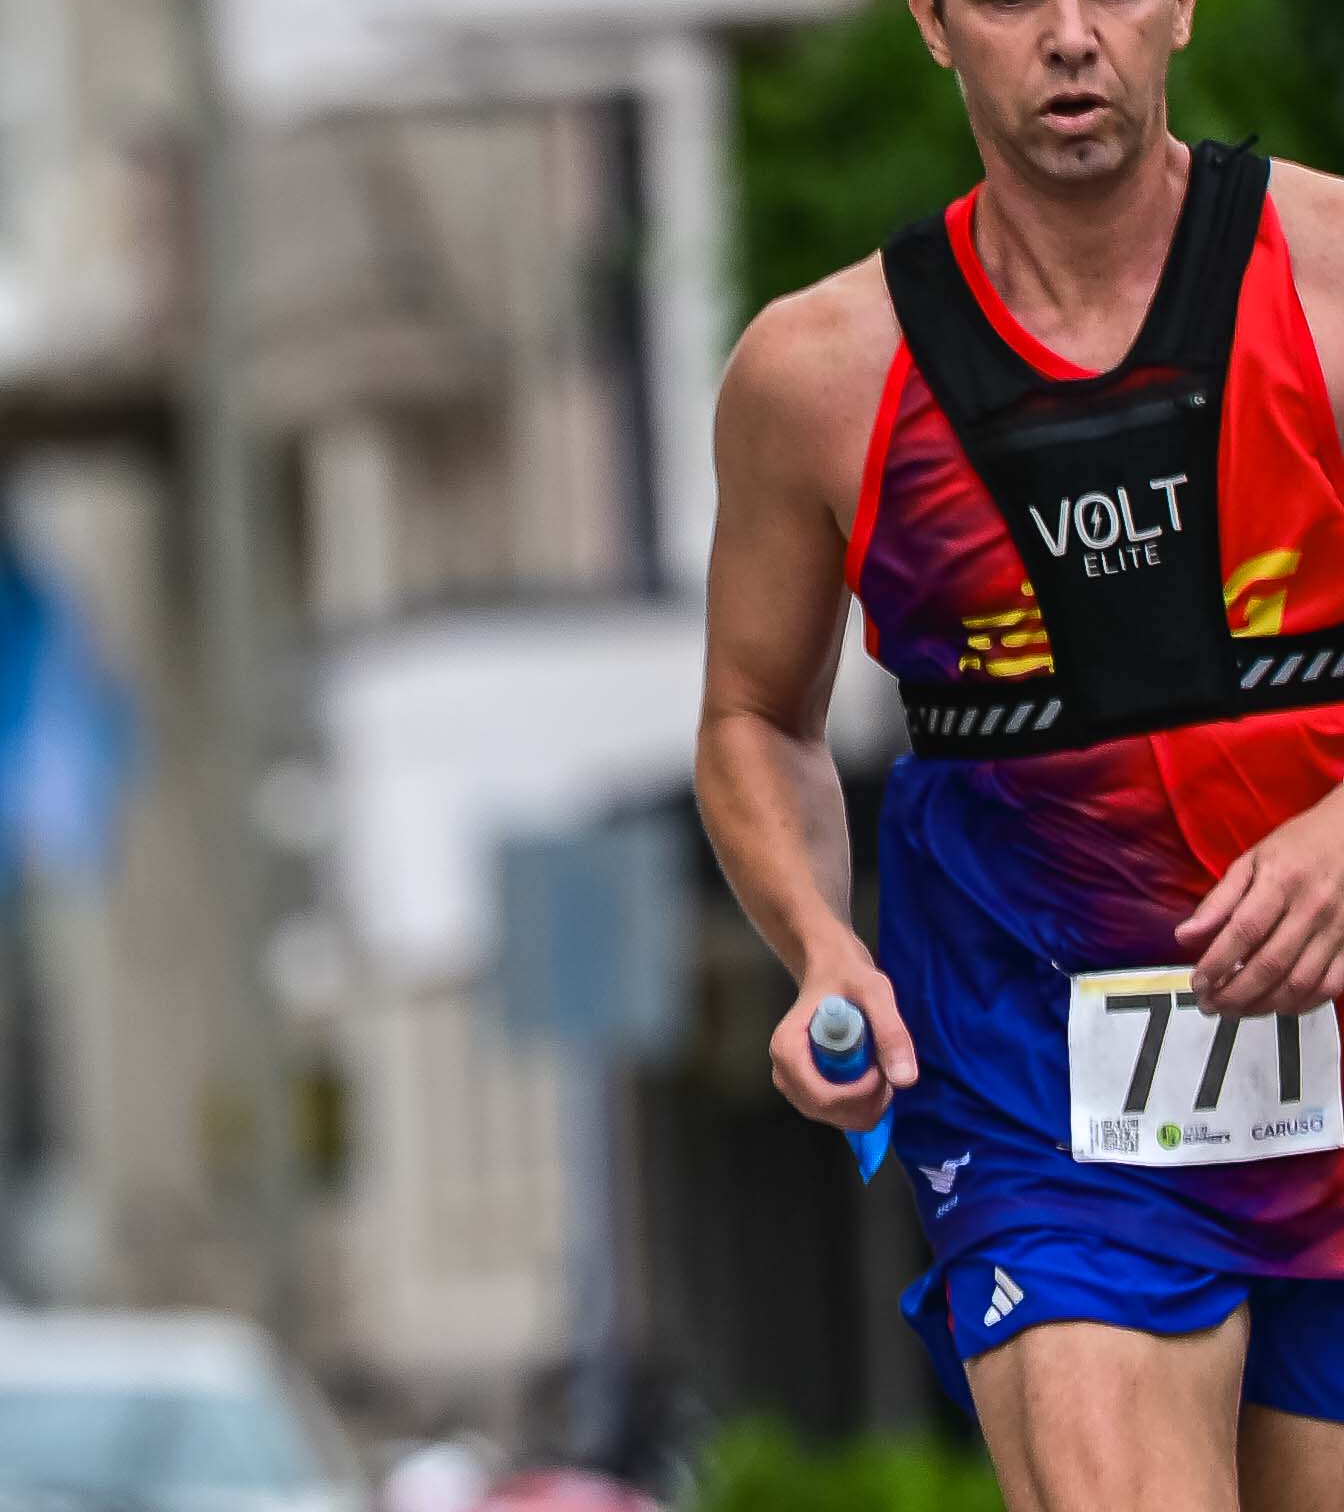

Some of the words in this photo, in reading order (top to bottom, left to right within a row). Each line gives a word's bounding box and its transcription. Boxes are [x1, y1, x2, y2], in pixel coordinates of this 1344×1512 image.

[1029, 473, 1188, 557] VOLT
[1083, 542, 1161, 578] ELITE
[1251, 1115, 1324, 1142] CARUSO
